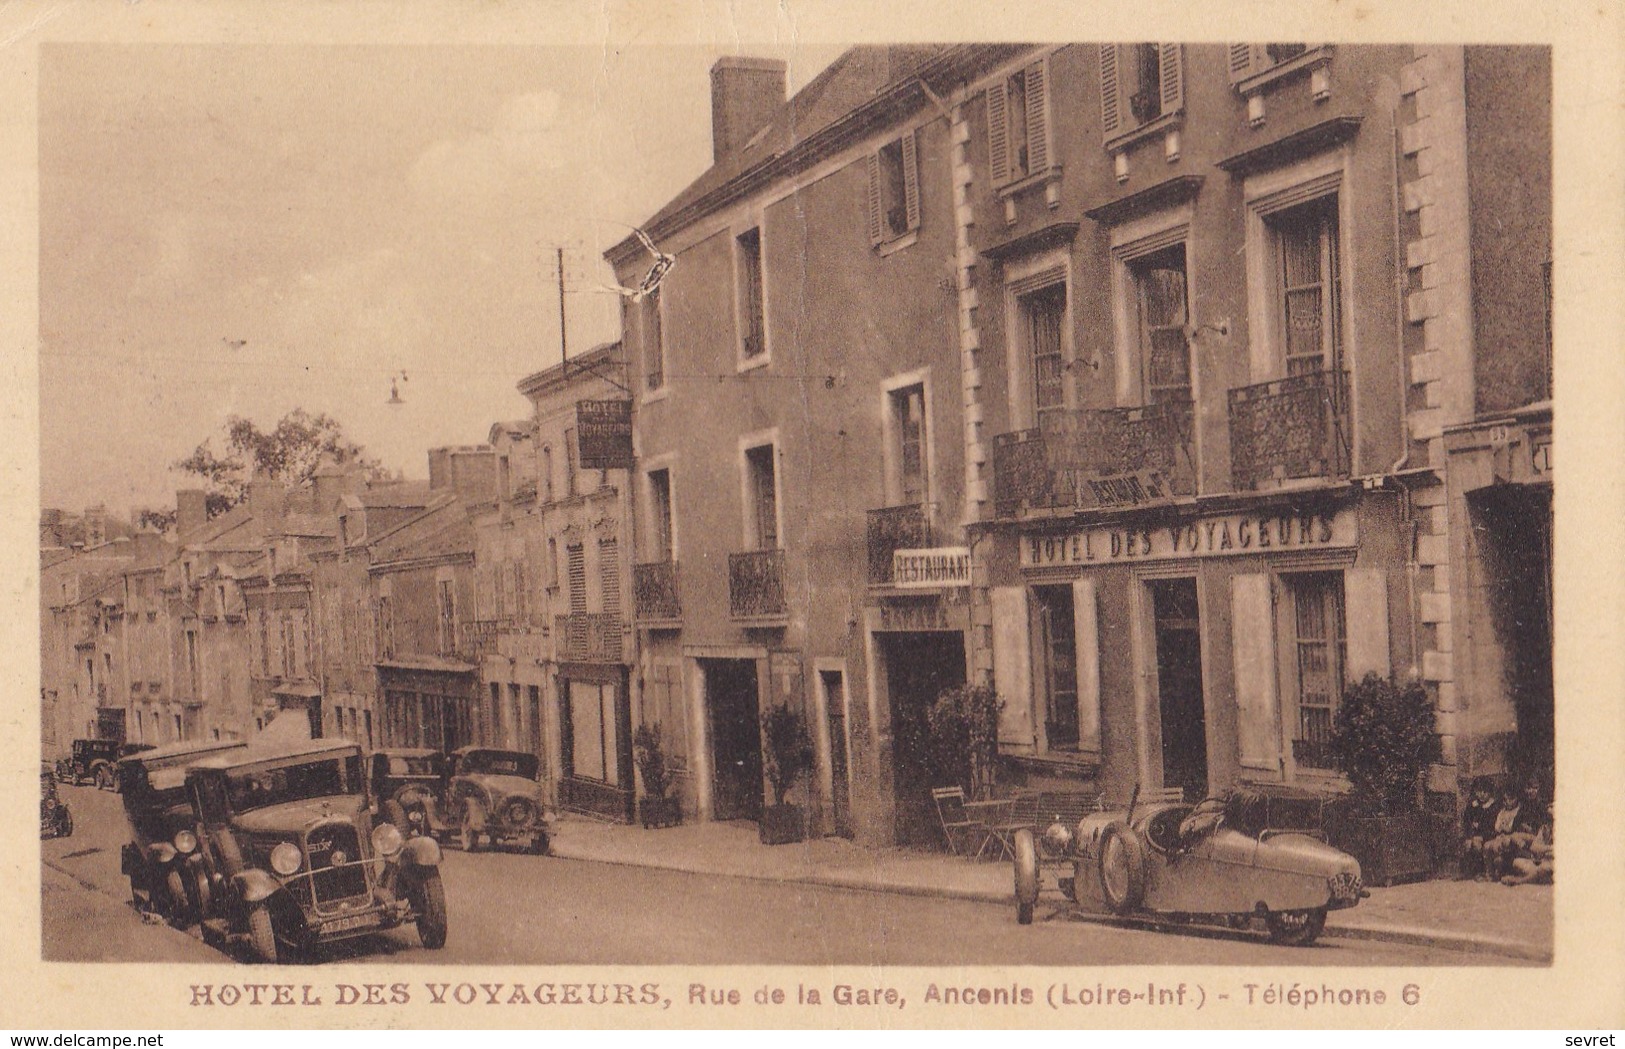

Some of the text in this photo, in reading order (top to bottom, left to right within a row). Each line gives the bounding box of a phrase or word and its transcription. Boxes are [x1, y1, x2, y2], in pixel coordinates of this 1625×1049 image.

[1030, 514, 1335, 564] HOTEL DES VOYAGEURS
[894, 554, 969, 584] RESTAURANT
